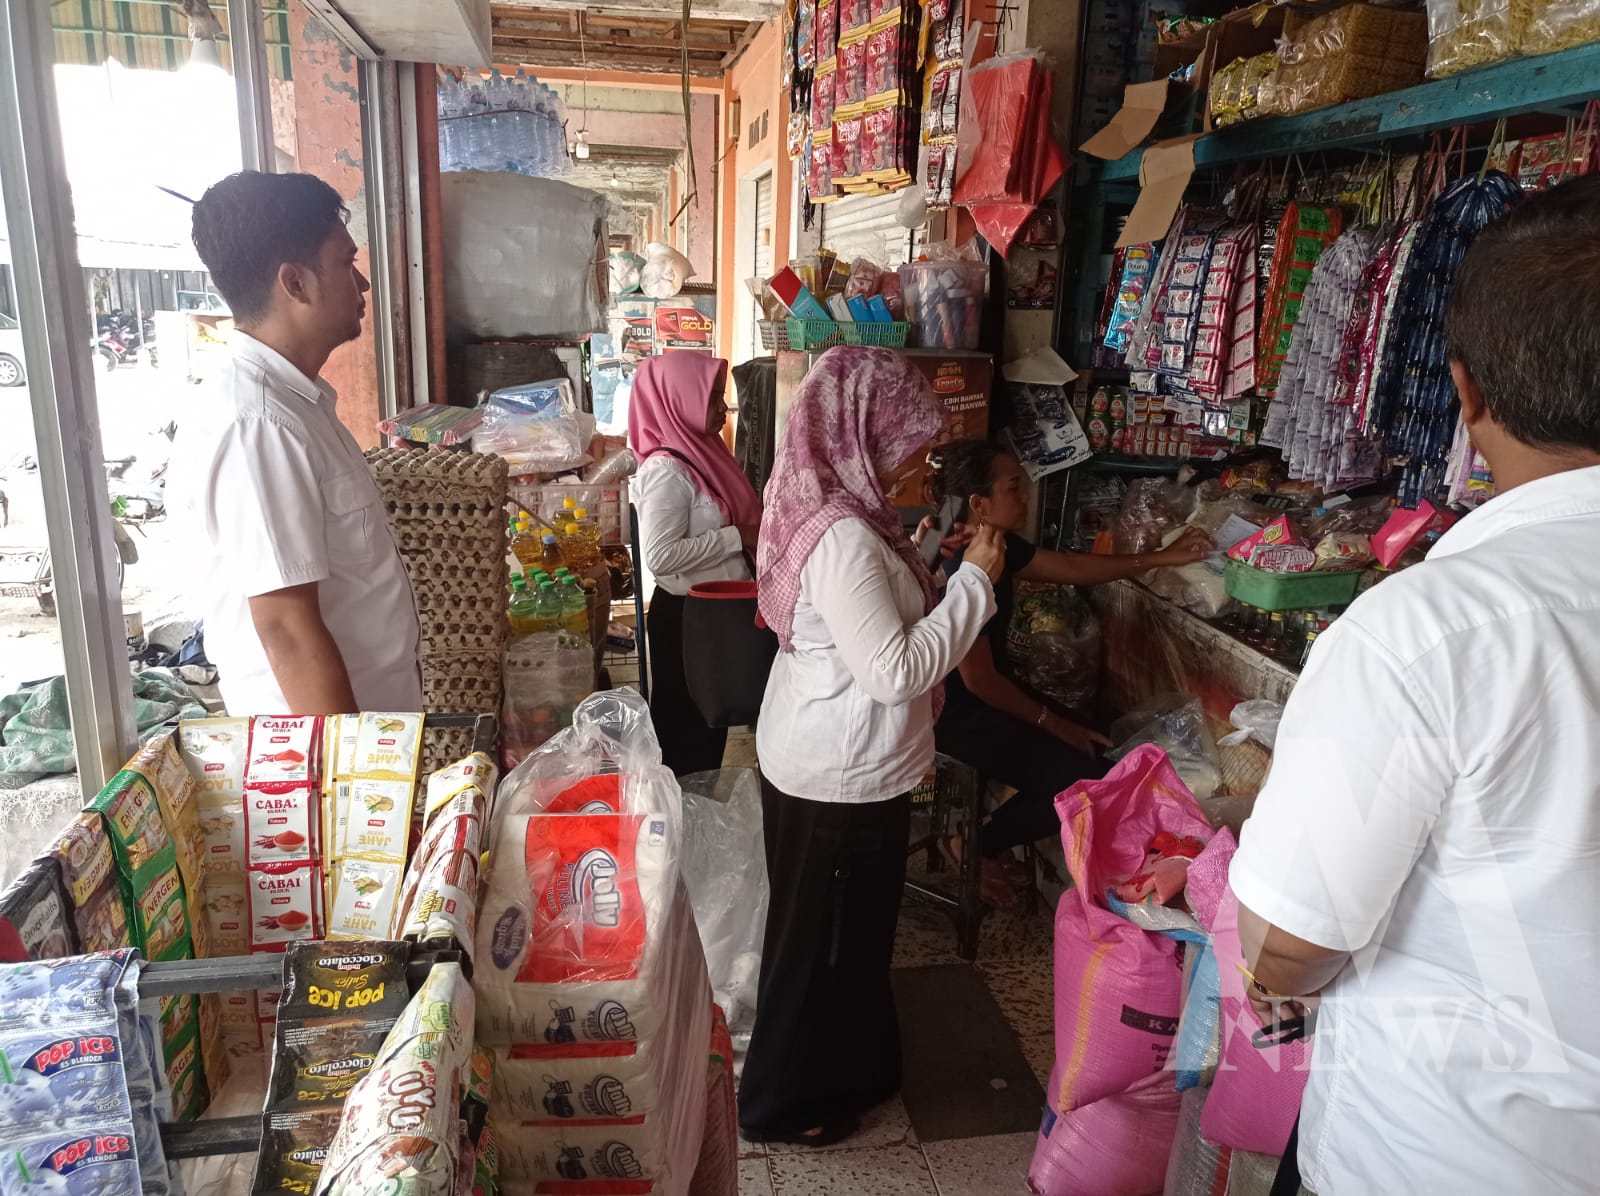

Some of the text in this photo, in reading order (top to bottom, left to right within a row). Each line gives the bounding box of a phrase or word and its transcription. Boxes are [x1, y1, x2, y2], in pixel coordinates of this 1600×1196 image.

[680, 321, 712, 330] GOLD
[262, 720, 305, 729] CABAI
[358, 834, 392, 846] JAHE
[258, 878, 301, 890] CABAI
[318, 955, 384, 969] Cioccolato
[345, 981, 385, 1008] POP
[34, 1040, 76, 1073] POP
[71, 1055, 104, 1065] BLENDER
[308, 1057, 376, 1074] Cioccolato
[387, 1071, 436, 1129] UYU
[51, 1138, 92, 1171] POP
[87, 1153, 119, 1164] BLENDER
[293, 1147, 329, 1161] colato
